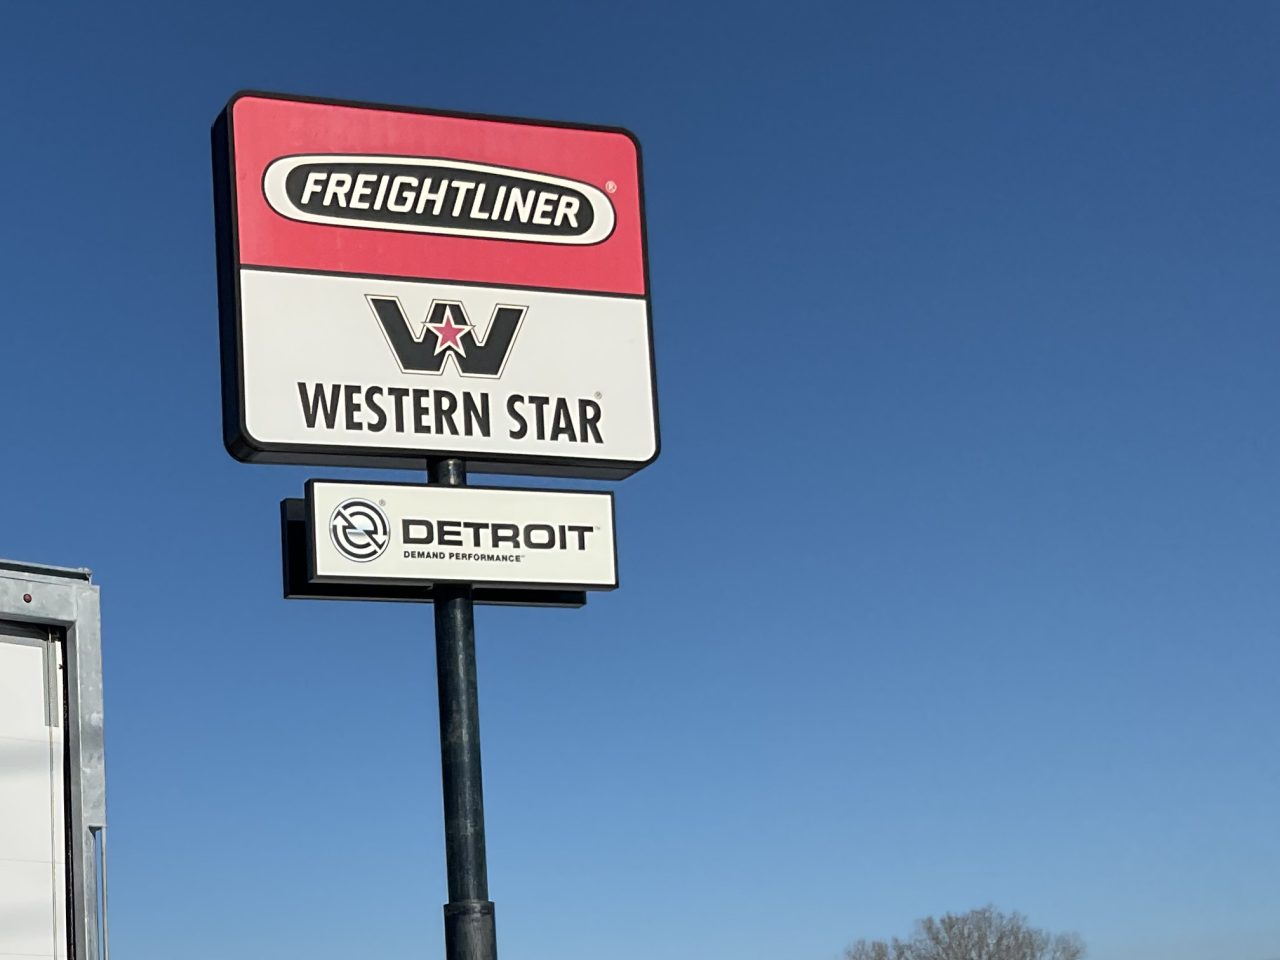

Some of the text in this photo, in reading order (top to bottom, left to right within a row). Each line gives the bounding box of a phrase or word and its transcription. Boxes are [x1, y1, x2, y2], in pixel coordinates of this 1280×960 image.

[301, 172, 581, 229] FREIGHTLINER
[297, 382, 604, 444] WESTERN STAR
[401, 518, 594, 551] DETROIT
[403, 550, 521, 563] DEMAND PERFORMANCE
